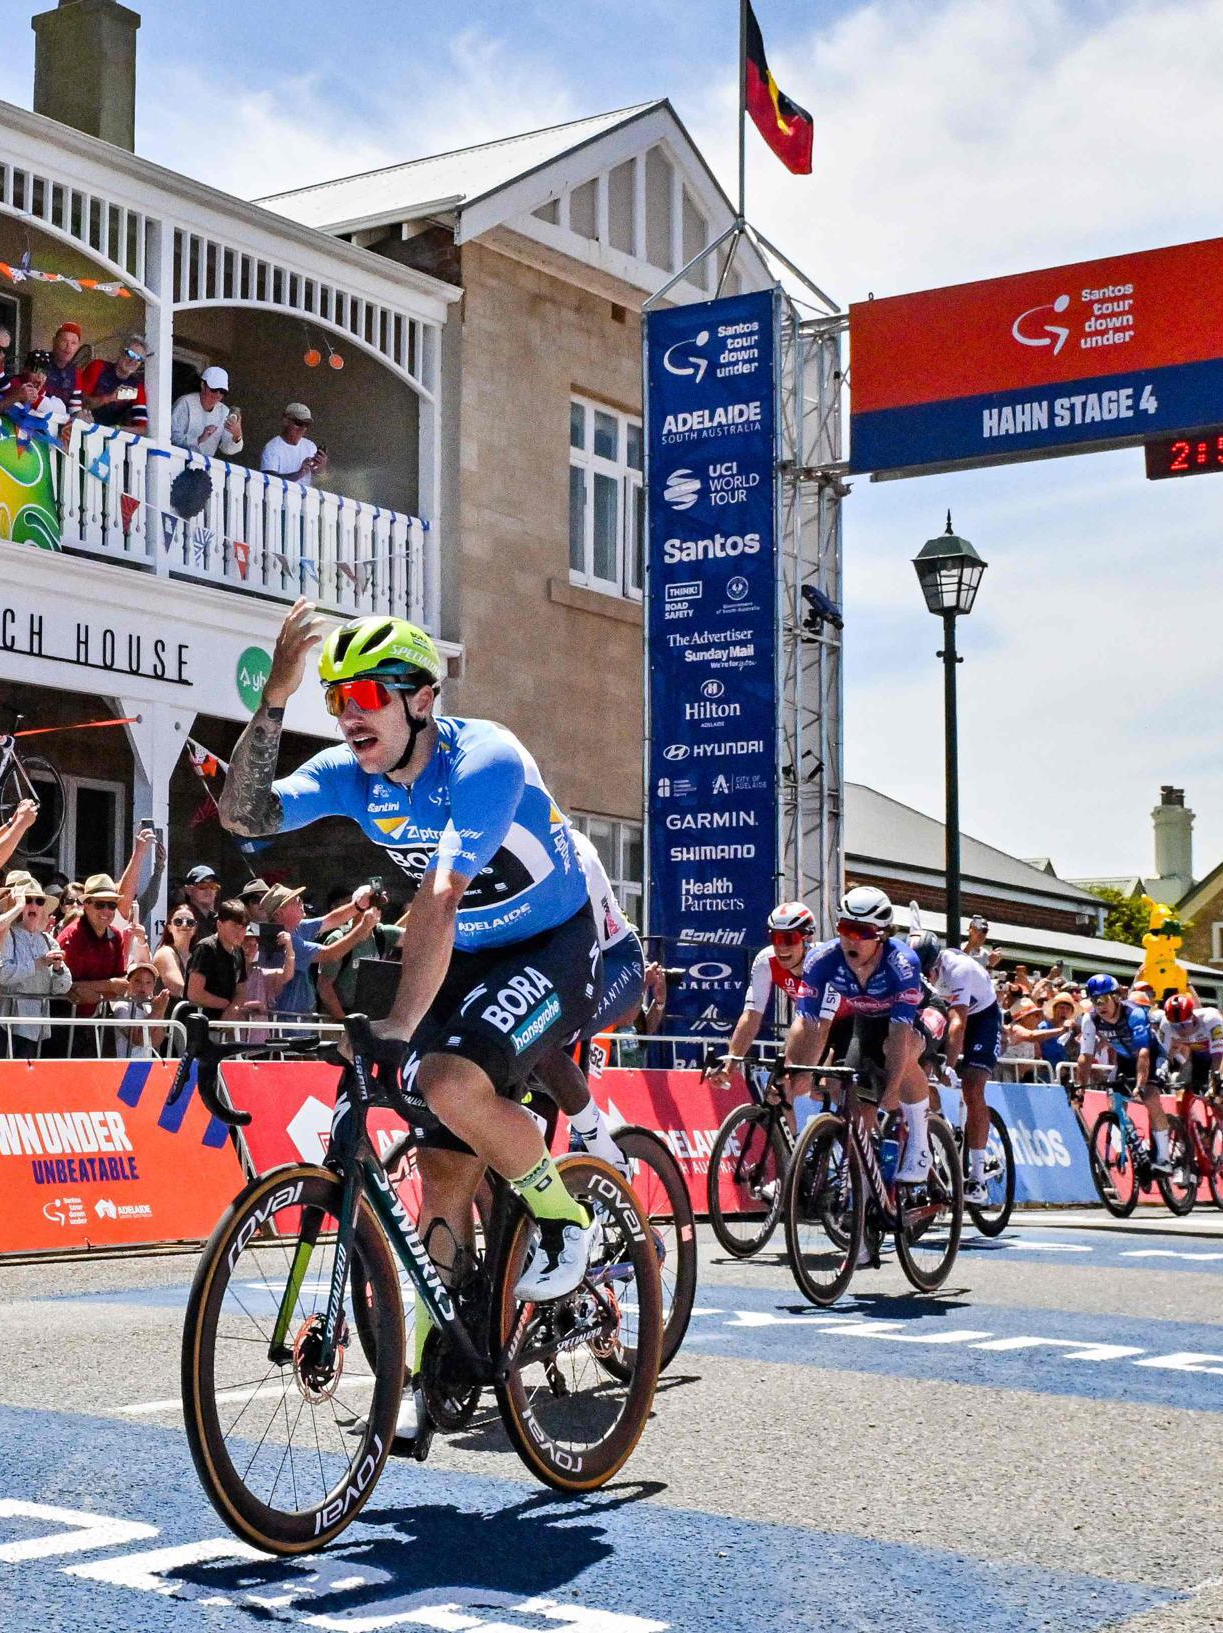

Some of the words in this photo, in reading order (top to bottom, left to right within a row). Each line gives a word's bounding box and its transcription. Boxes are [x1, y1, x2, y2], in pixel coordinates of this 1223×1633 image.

[1080, 283, 1134, 302] Santos
[1093, 299, 1134, 315] tour
[717, 321, 759, 337] Santos
[1084, 314, 1134, 332] down
[726, 336, 759, 350] tour
[1080, 329, 1135, 349] under
[720, 348, 759, 364] down
[716, 361, 759, 378] under
[662, 401, 762, 435] ADELAIDE
[982, 401, 1048, 438] HAHN
[1054, 388, 1134, 427] STAGE
[1139, 385, 1157, 414] 4
[661, 430, 698, 445] SOUTH
[700, 422, 762, 441] AUSTRALIA
[709, 462, 738, 477] UCI
[709, 473, 760, 490] WORLD
[709, 489, 747, 506] TOUR
[664, 532, 760, 565] Santos
[669, 586, 698, 596] THINK!
[665, 601, 689, 612] ROAD
[665, 609, 694, 620] SAFETY
[667, 633, 692, 647] The
[693, 628, 754, 645] Advertiser
[77, 623, 189, 686] HOUSE
[684, 649, 729, 663] Sunday
[729, 644, 755, 658] Mail
[253, 670, 268, 691] yh
[684, 702, 741, 721] Hilton
[693, 740, 764, 757] HYUNDAI
[367, 801, 399, 813] Santini
[666, 810, 756, 830] GARMIN
[406, 825, 448, 842] Ziptr
[670, 844, 756, 862] SHIMANO
[681, 877, 733, 895] Health
[681, 895, 746, 912] Partners
[677, 927, 747, 946] Santini
[481, 966, 554, 1034] BORA
[511, 999, 560, 1051] hansgrohe
[37, 1111, 133, 1154] UNDER
[32, 1156, 139, 1184] UNBEATABLE
[327, 1243, 347, 1343] SPECIALIZED
[556, 1325, 603, 1351] SPECIALIZED
